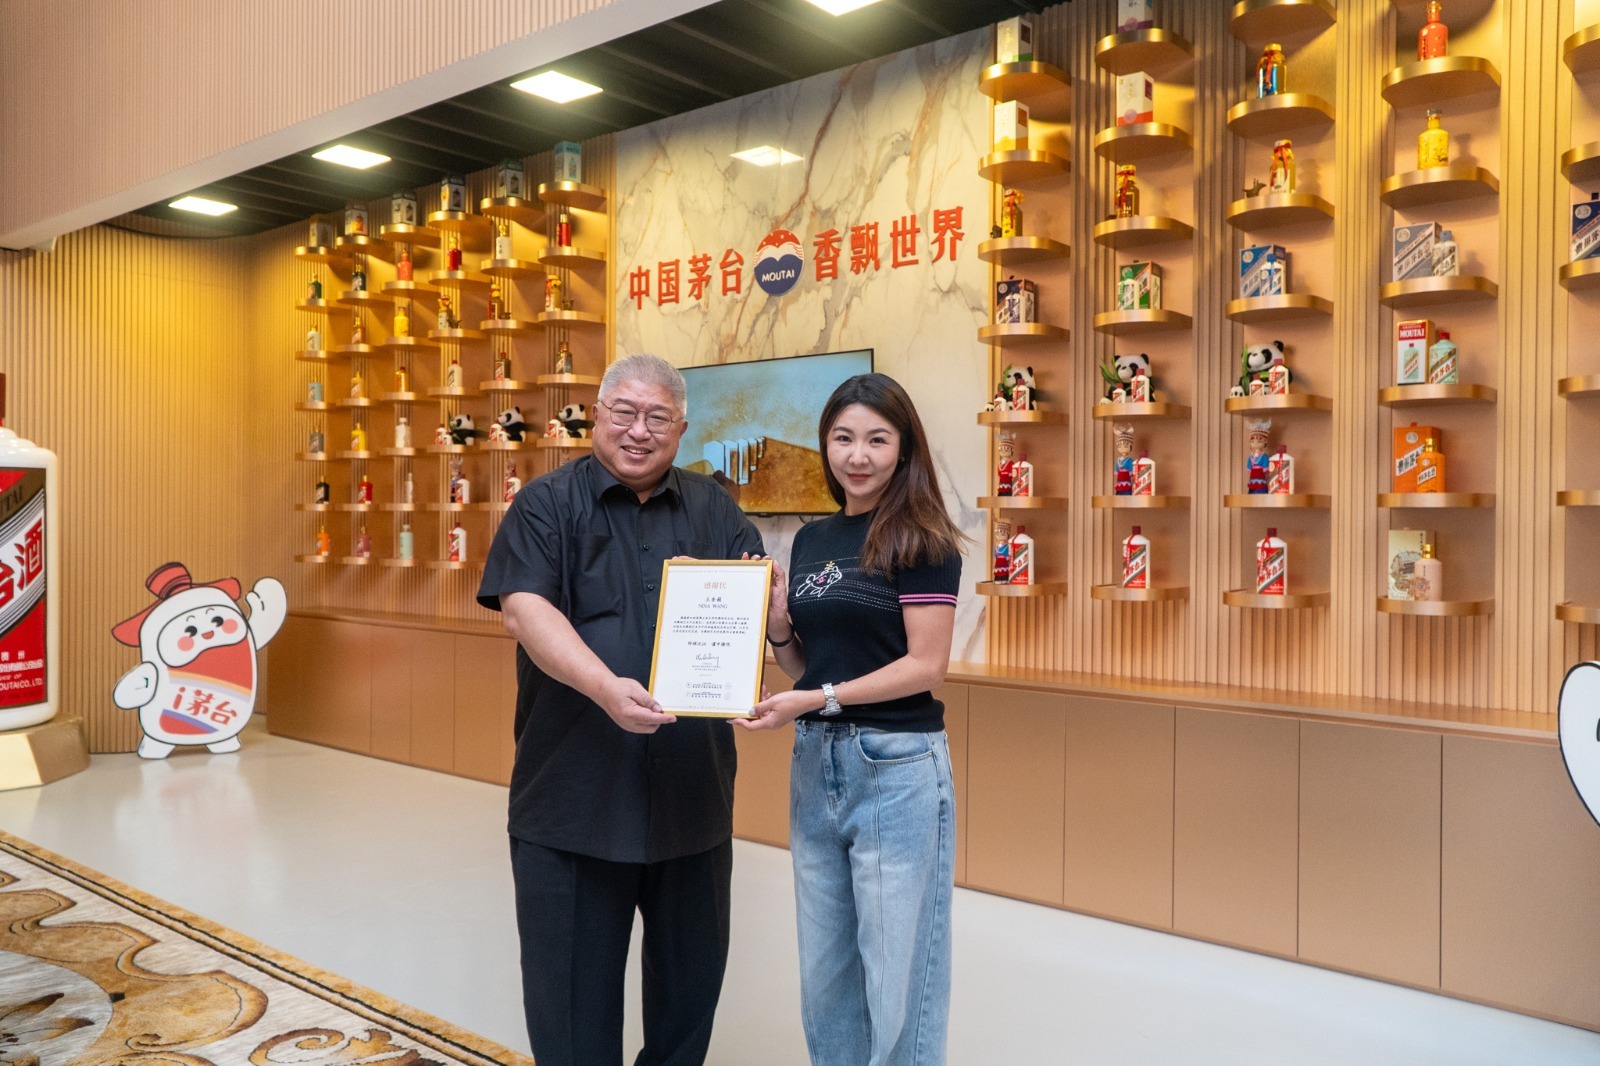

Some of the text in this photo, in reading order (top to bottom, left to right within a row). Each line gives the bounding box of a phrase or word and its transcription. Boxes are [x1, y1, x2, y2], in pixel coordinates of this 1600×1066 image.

[629, 206, 965, 310] 中国茅台 香飘世界
[761, 269, 795, 283] MOUTAI
[1400, 328, 1425, 338] MOUTAI
